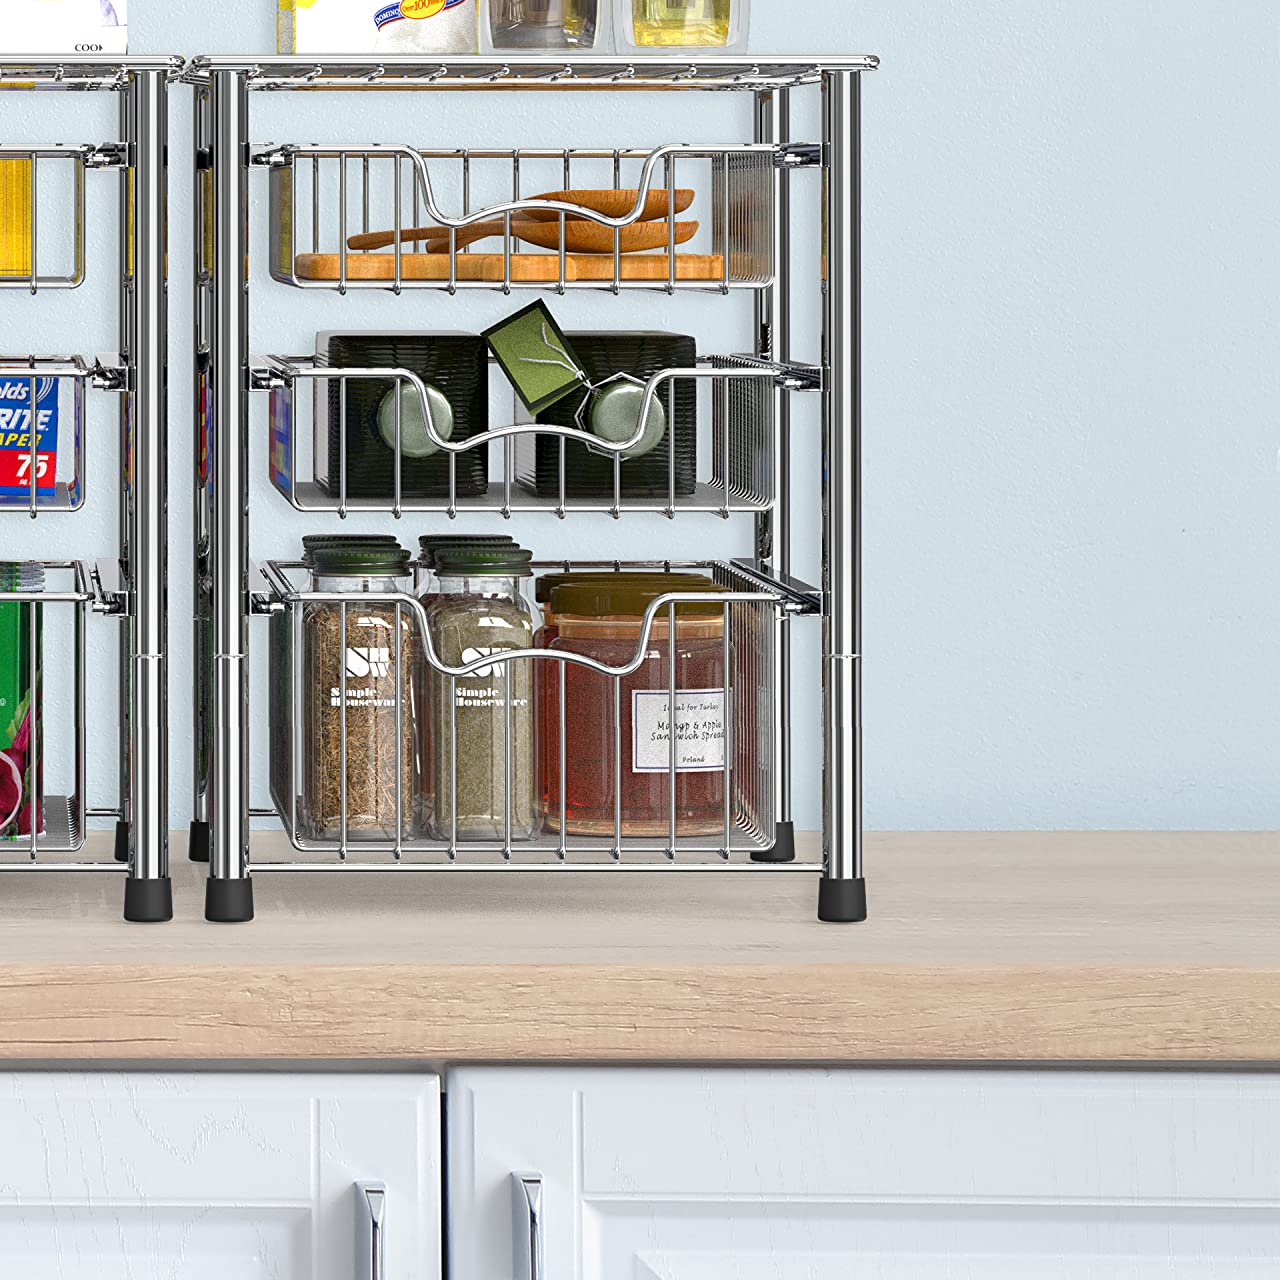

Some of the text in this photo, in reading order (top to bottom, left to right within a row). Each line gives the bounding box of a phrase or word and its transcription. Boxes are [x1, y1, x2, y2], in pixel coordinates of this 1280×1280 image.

[375, 8, 400, 24] DOMINO
[16, 454, 49, 479] 75
[330, 688, 377, 697] Smple
[456, 688, 500, 697] Simple
[686, 703, 697, 712] for
[702, 720, 722, 731] Apple
[651, 731, 699, 741] Sanwich
[682, 755, 705, 763] Poland
